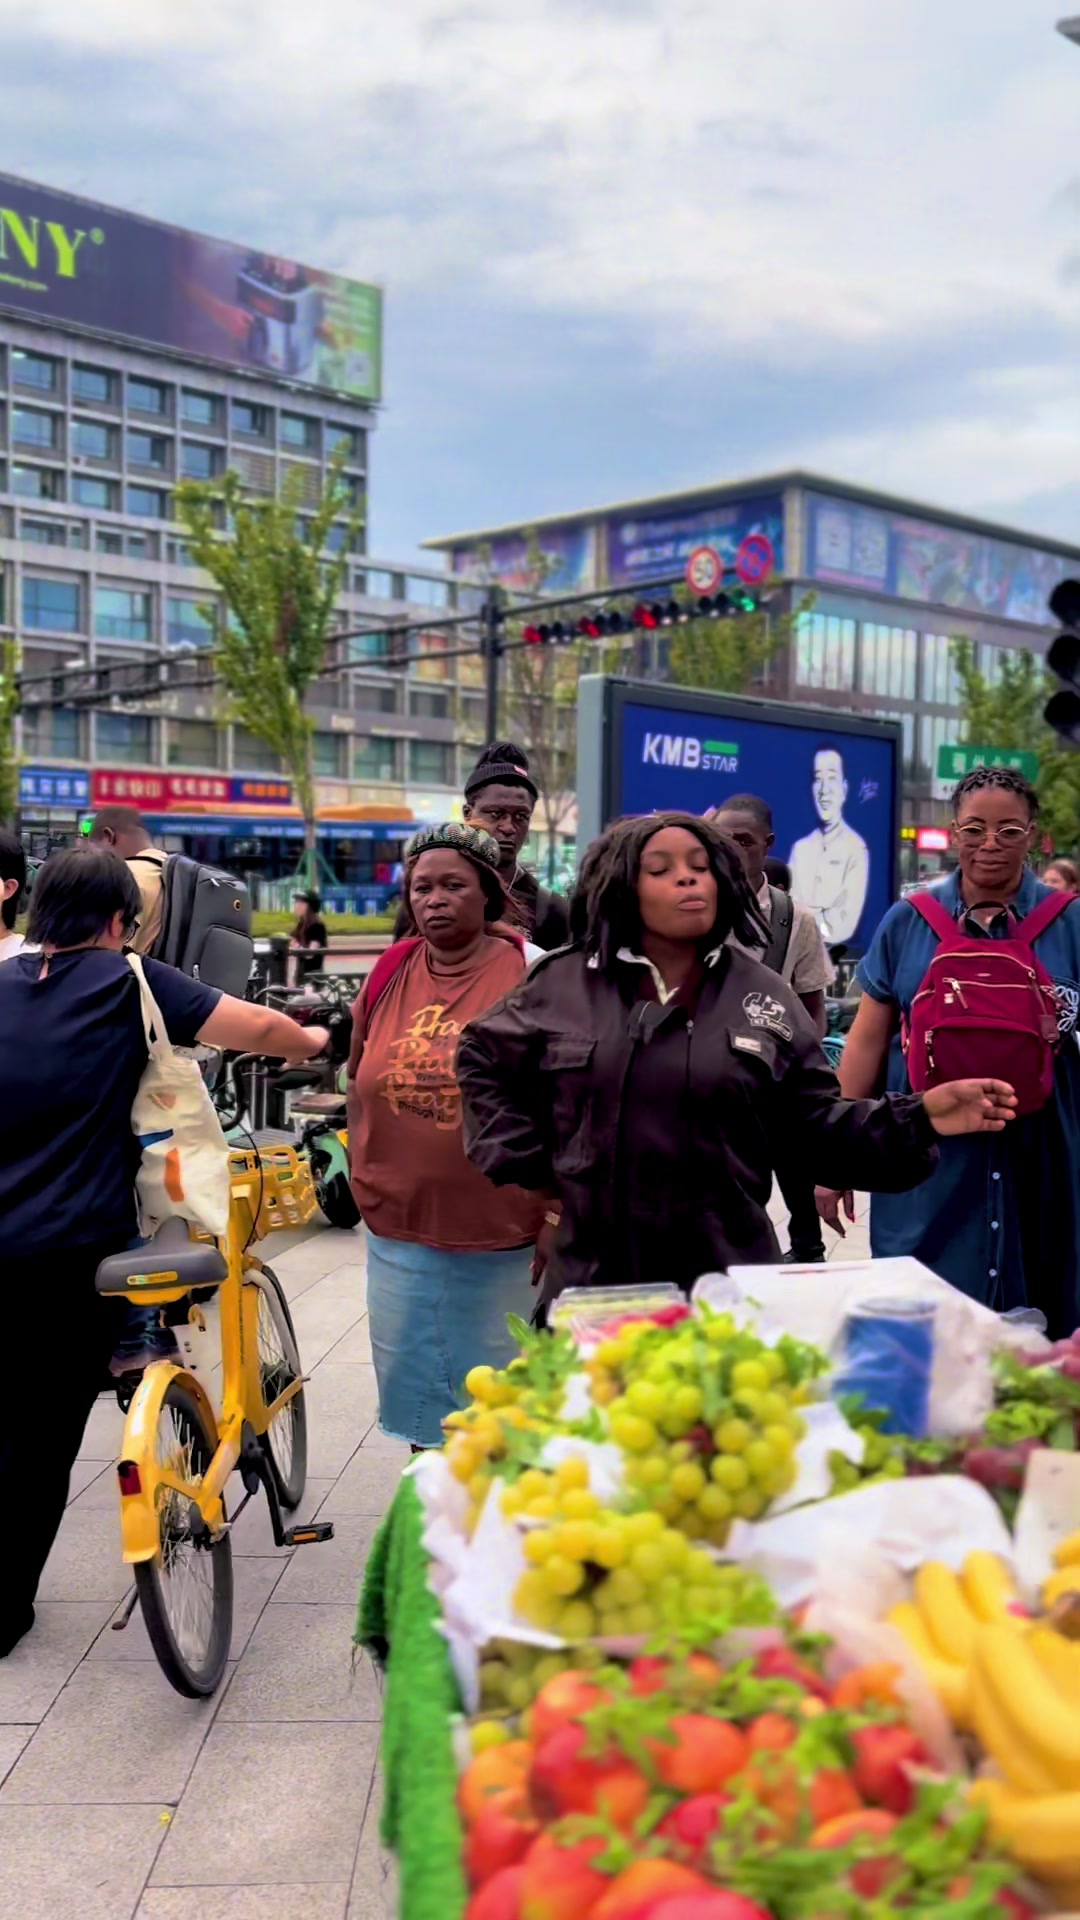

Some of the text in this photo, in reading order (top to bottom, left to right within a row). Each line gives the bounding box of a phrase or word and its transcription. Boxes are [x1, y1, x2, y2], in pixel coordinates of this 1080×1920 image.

[642, 732, 701, 769] KMB
[702, 753, 739, 773] STAR
[405, 1004, 460, 1038] Pra
